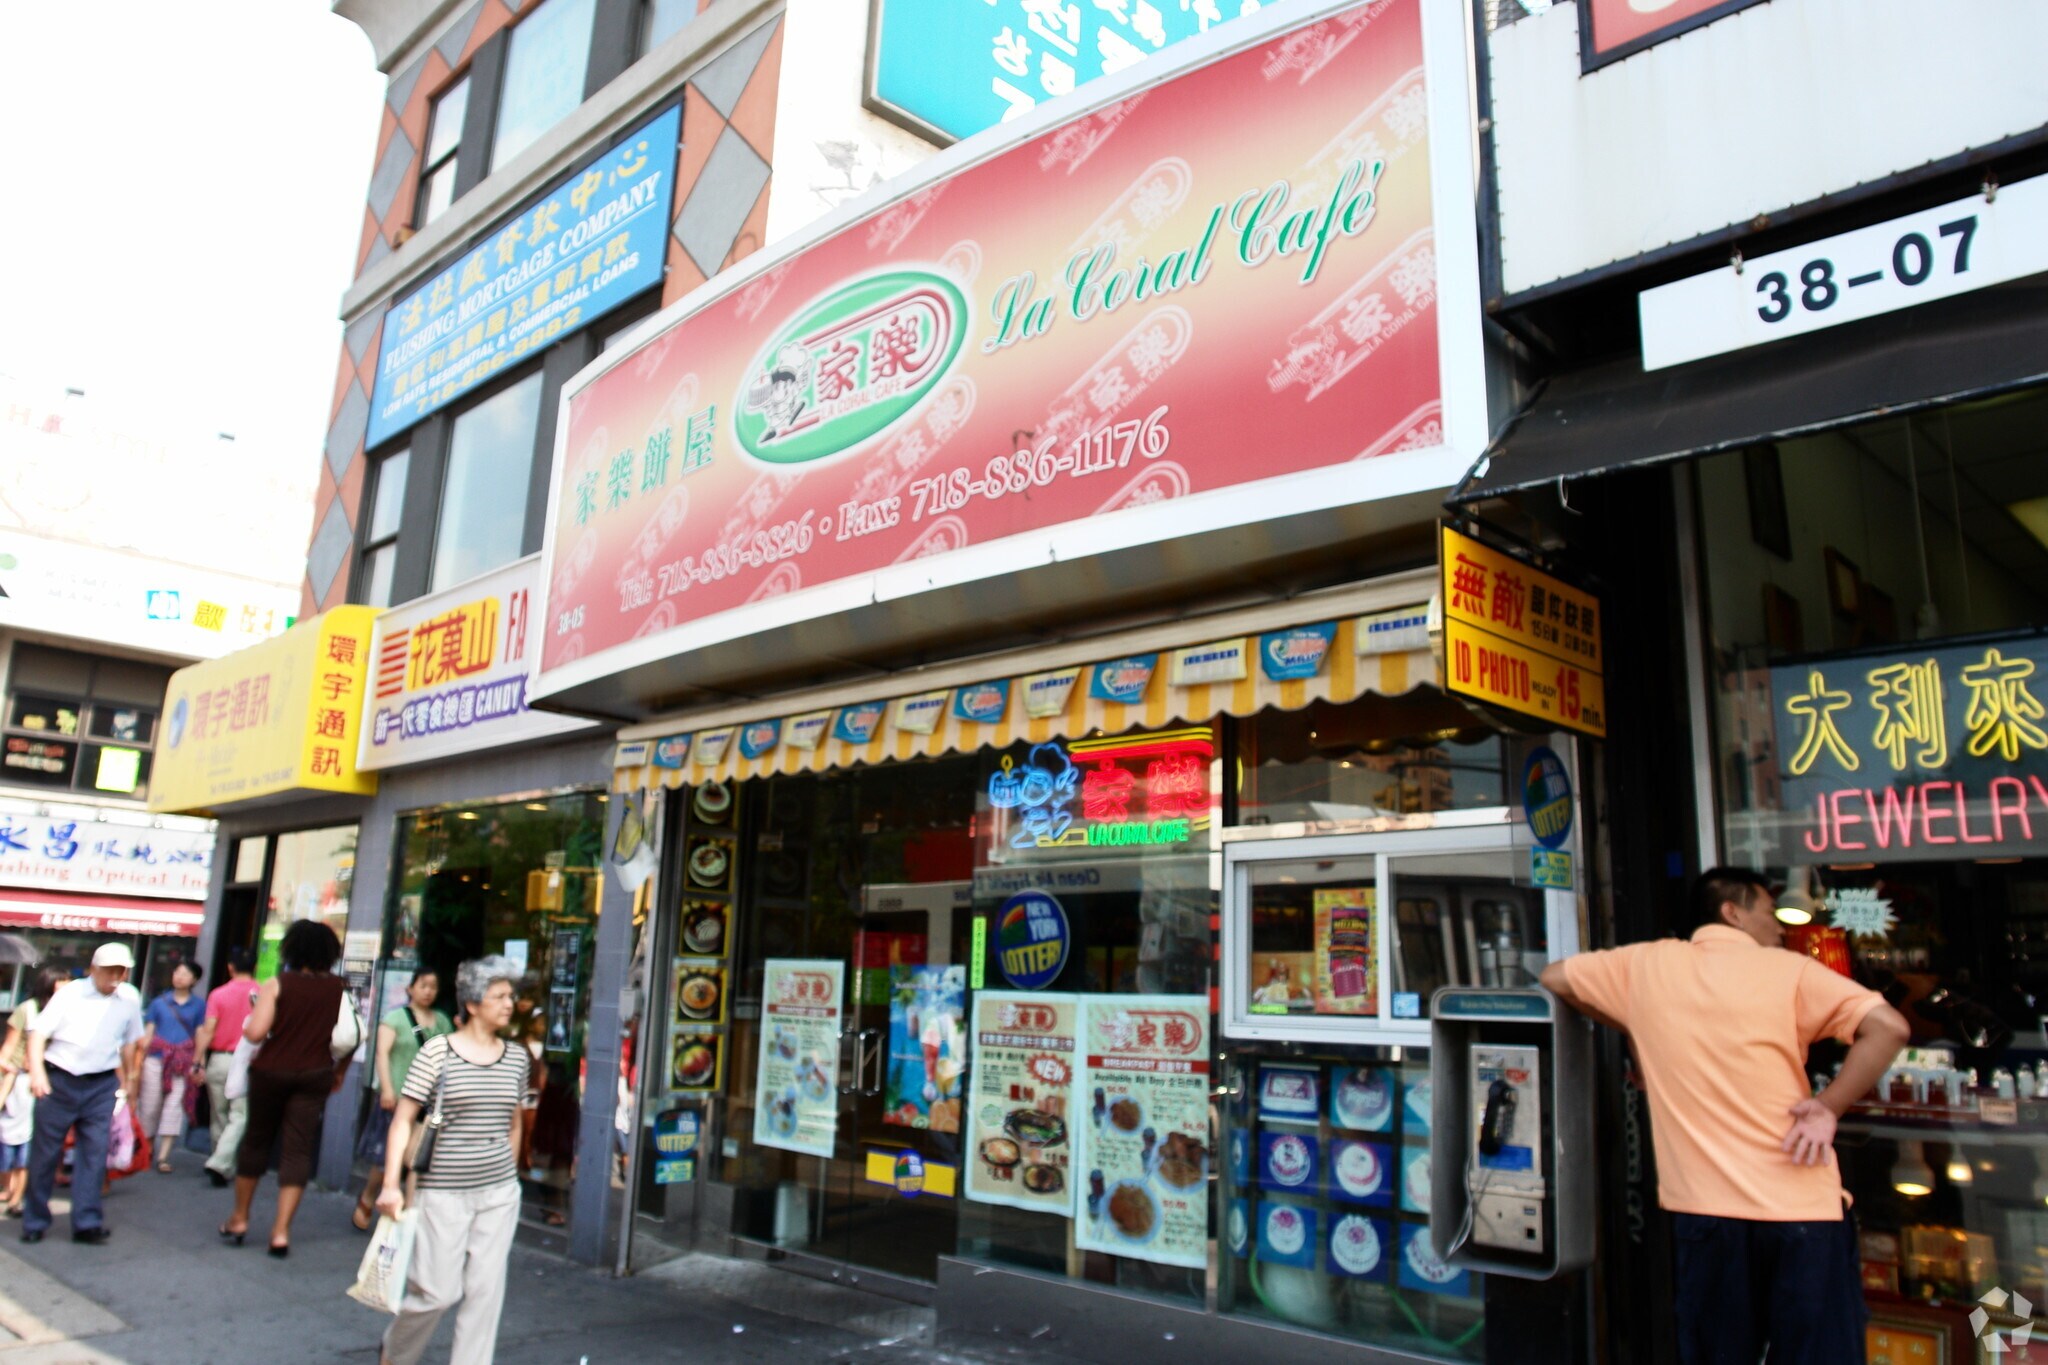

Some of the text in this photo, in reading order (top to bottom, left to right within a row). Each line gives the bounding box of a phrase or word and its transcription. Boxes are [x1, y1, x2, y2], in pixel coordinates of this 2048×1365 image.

[385, 171, 661, 372] FLUSHING MORTGAGE COMPANY
[981, 158, 1386, 355] La Coral Café
[1757, 215, 1979, 323] 38-07
[383, 400, 402, 419] LOW
[403, 386, 428, 409] RATE
[429, 343, 496, 393] RESIDENTIAL
[509, 288, 590, 342] COMMERCIAL
[593, 252, 640, 291] LOANS
[620, 405, 1170, 612] Tel: 718-886-8826 Fax: 718-886-1176
[1452, 553, 1526, 632] 無敵
[411, 599, 496, 690] 花菓山
[1455, 639, 1605, 729] ID PHOTO 15 min.
[1532, 680, 1558, 700] READY
[310, 634, 357, 777] 環宇通訊
[476, 678, 522, 717] CANDY
[1786, 647, 2048, 776] 大利來
[87, 864, 168, 886] Optical
[1034, 1060, 1064, 1083] NEW
